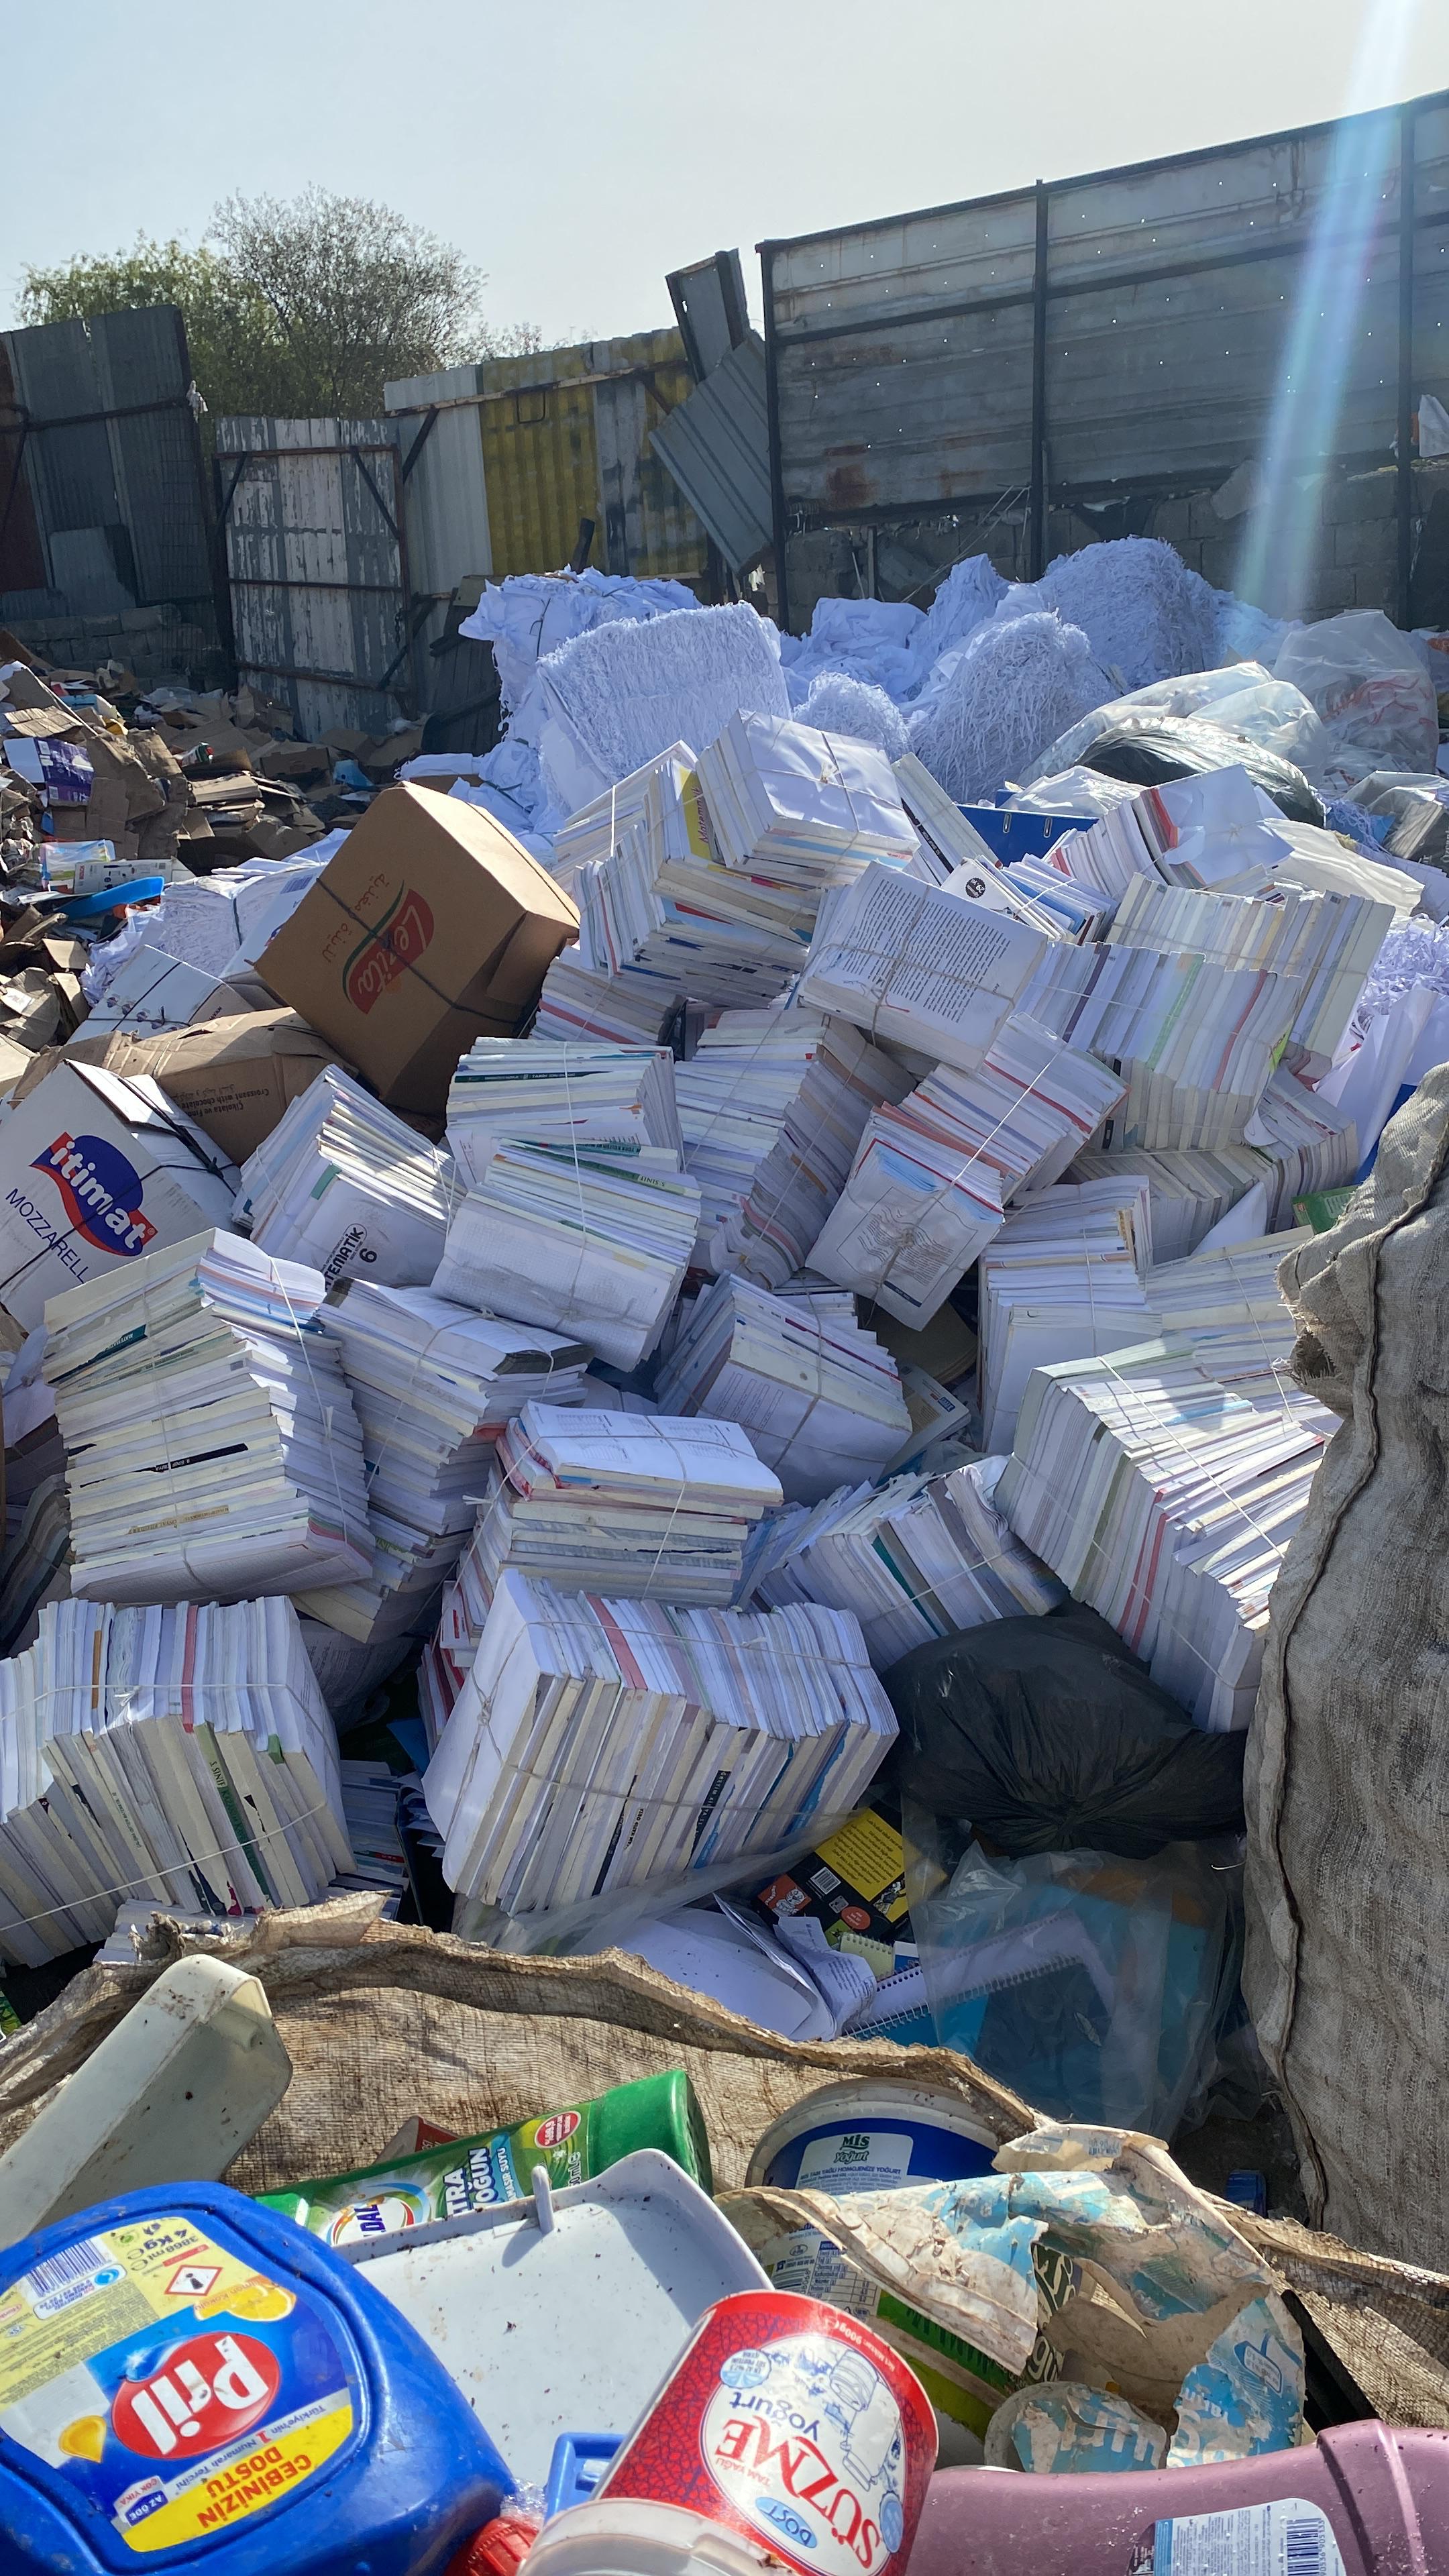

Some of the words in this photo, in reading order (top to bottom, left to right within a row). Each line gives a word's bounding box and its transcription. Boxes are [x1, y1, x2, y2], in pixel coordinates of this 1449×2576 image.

[213, 1099, 244, 1114] Çikolata
[216, 1094, 233, 1104] with
[235, 1088, 269, 1100] Croissant
[50, 1140, 146, 1249] itimat
[359, 1248, 377, 1263] 6
[211, 1767, 225, 1788] SINIF
[500, 2174, 519, 2201] AMAŞIR
[174, 2229, 188, 2239] 4
[354, 2204, 386, 2237] DAL
[143, 2234, 173, 2250] Kg
[131, 2335, 268, 2455] Pril
[271, 2404, 326, 2434] Türkiye'nin
[729, 2392, 820, 2442] yoğurt
[256, 2430, 272, 2444] 1
[211, 2438, 257, 2469] Numaralı
[206, 2446, 283, 2498] DOSTU
[150, 2493, 163, 2508] AZ
[198, 2453, 312, 2528] CEBİNİZİN
[715, 2415, 880, 2569] SÜZME
[769, 2504, 812, 2545] DOST
